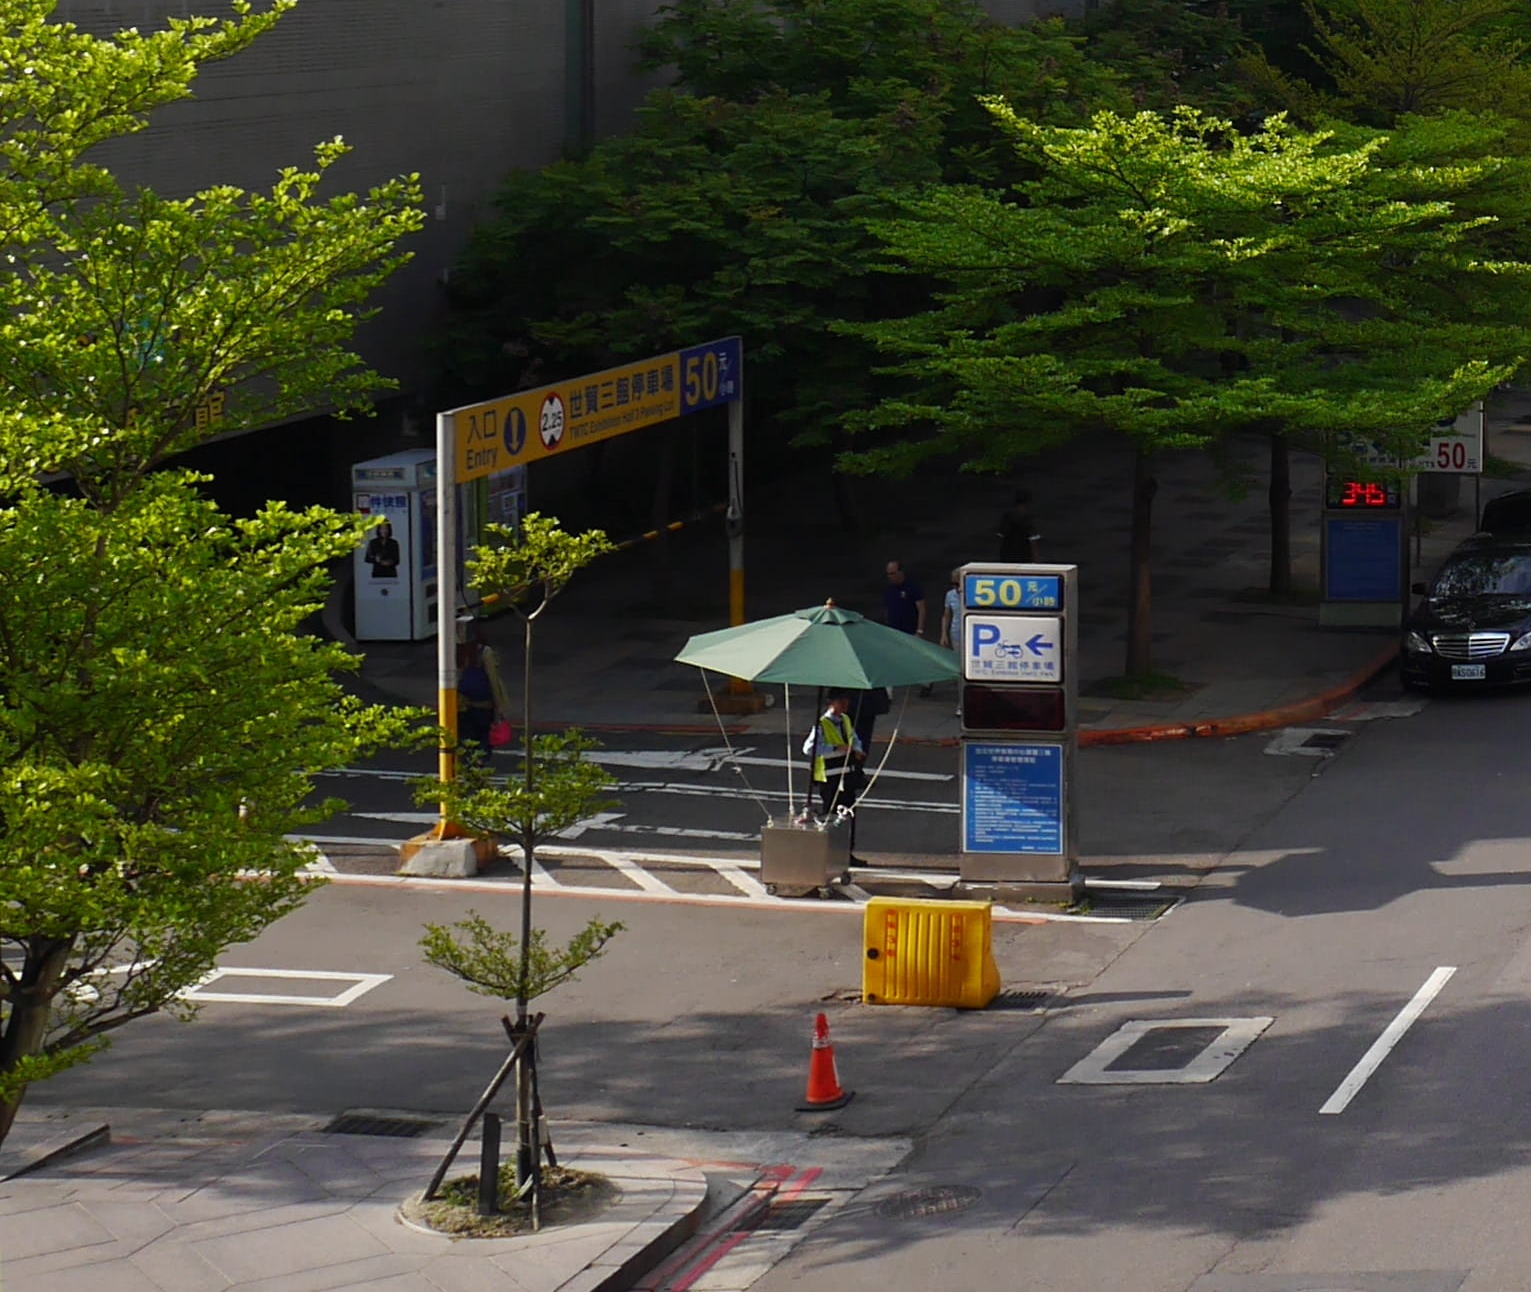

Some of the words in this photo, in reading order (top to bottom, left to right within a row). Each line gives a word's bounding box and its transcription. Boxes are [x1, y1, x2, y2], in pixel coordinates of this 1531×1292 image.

[569, 364, 674, 419] 世貿三館停車場
[686, 351, 718, 406] 50
[467, 410, 497, 443] 入口
[542, 411, 563, 432] 2.25
[466, 447, 498, 471] Entry
[1437, 442, 1466, 469] 50
[974, 579, 1022, 607] 50
[972, 623, 1001, 657] P
